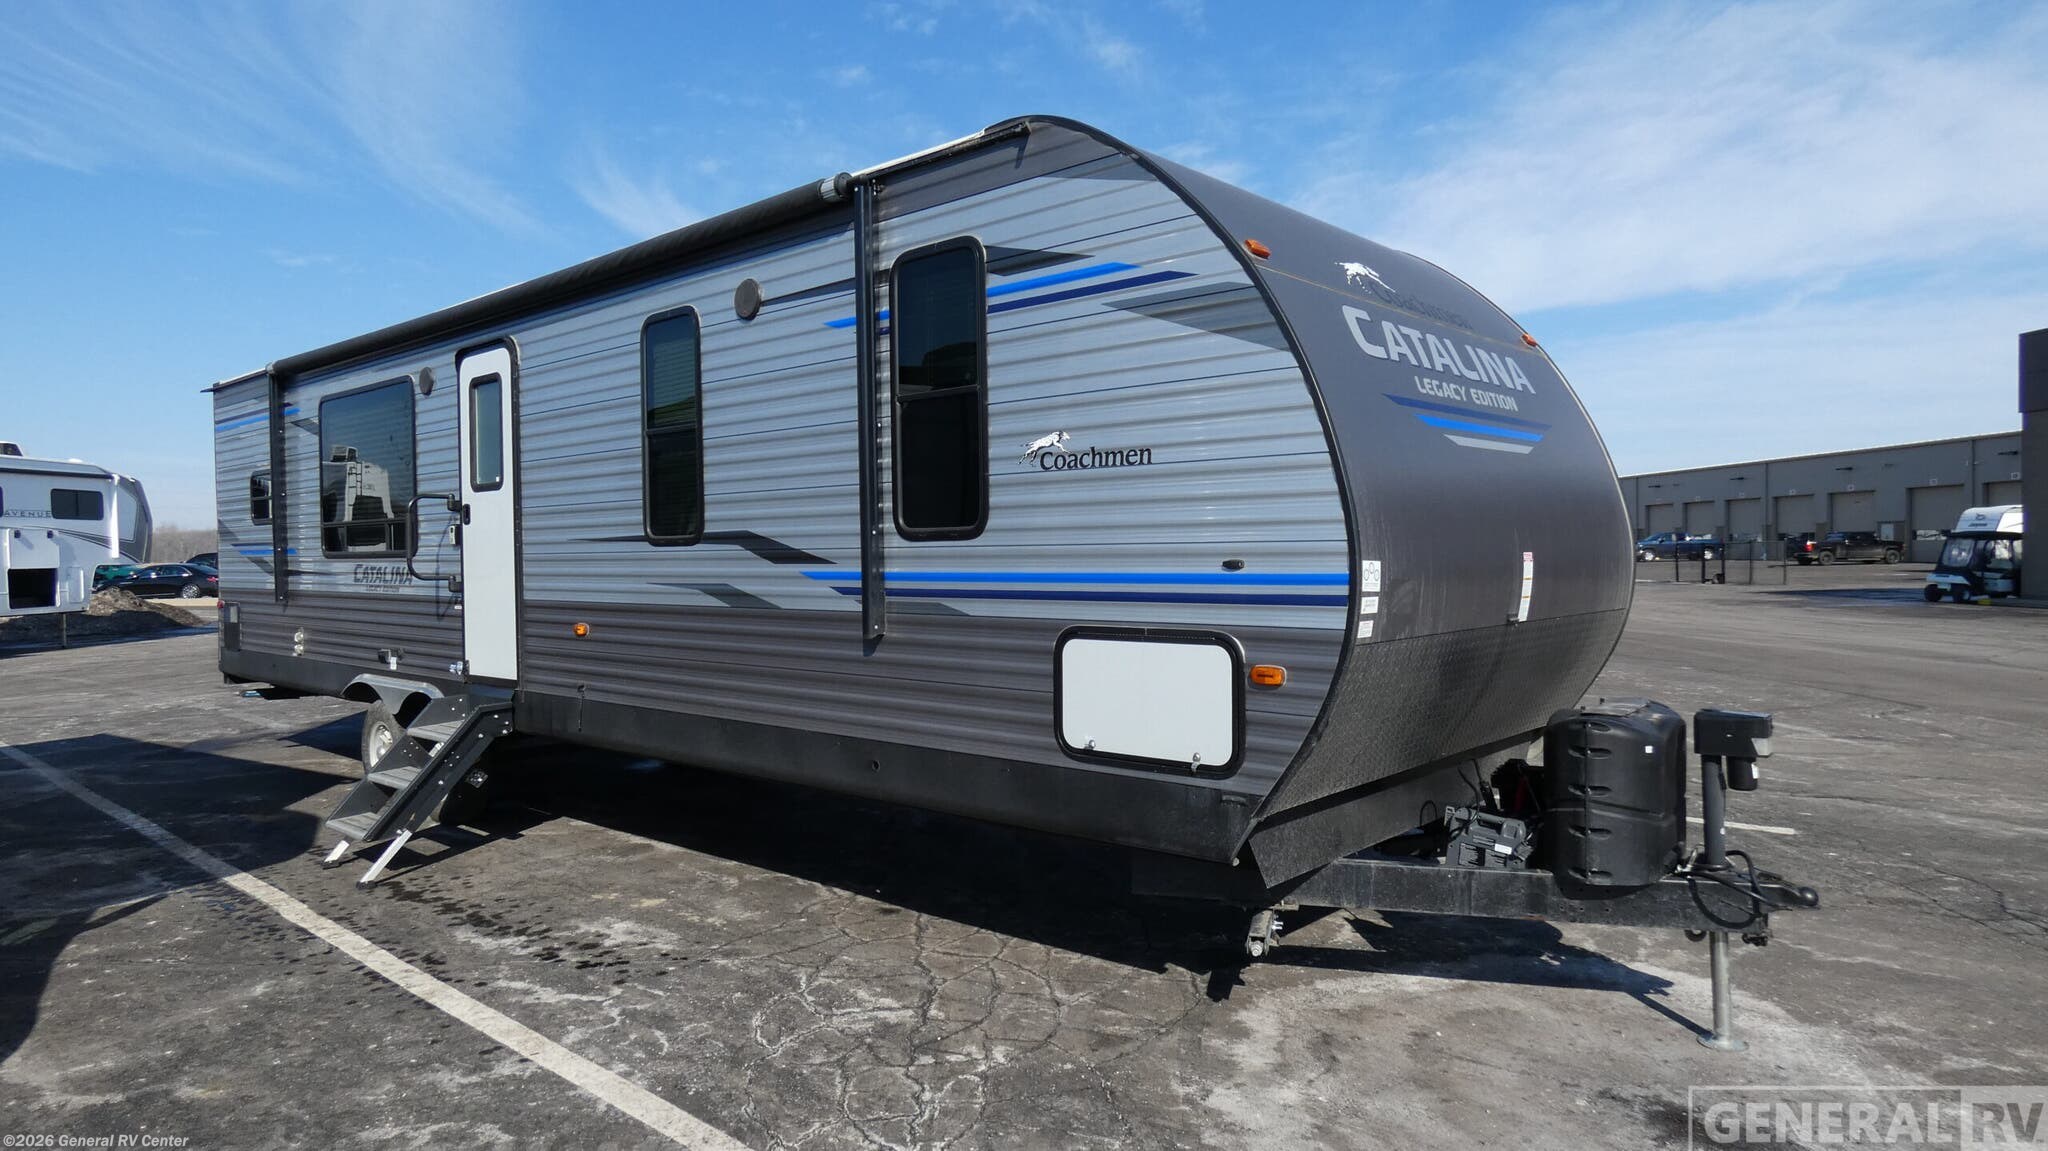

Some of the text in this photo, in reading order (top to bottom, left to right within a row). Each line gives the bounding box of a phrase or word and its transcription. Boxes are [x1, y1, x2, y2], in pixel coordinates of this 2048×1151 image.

[1341, 305, 1536, 394] CATALINA
[1414, 375, 1519, 412] LEGACY EDITION
[1040, 446, 1153, 471] Coachmen
[4, 510, 52, 518] AVENUE
[353, 563, 413, 585] CATALINA
